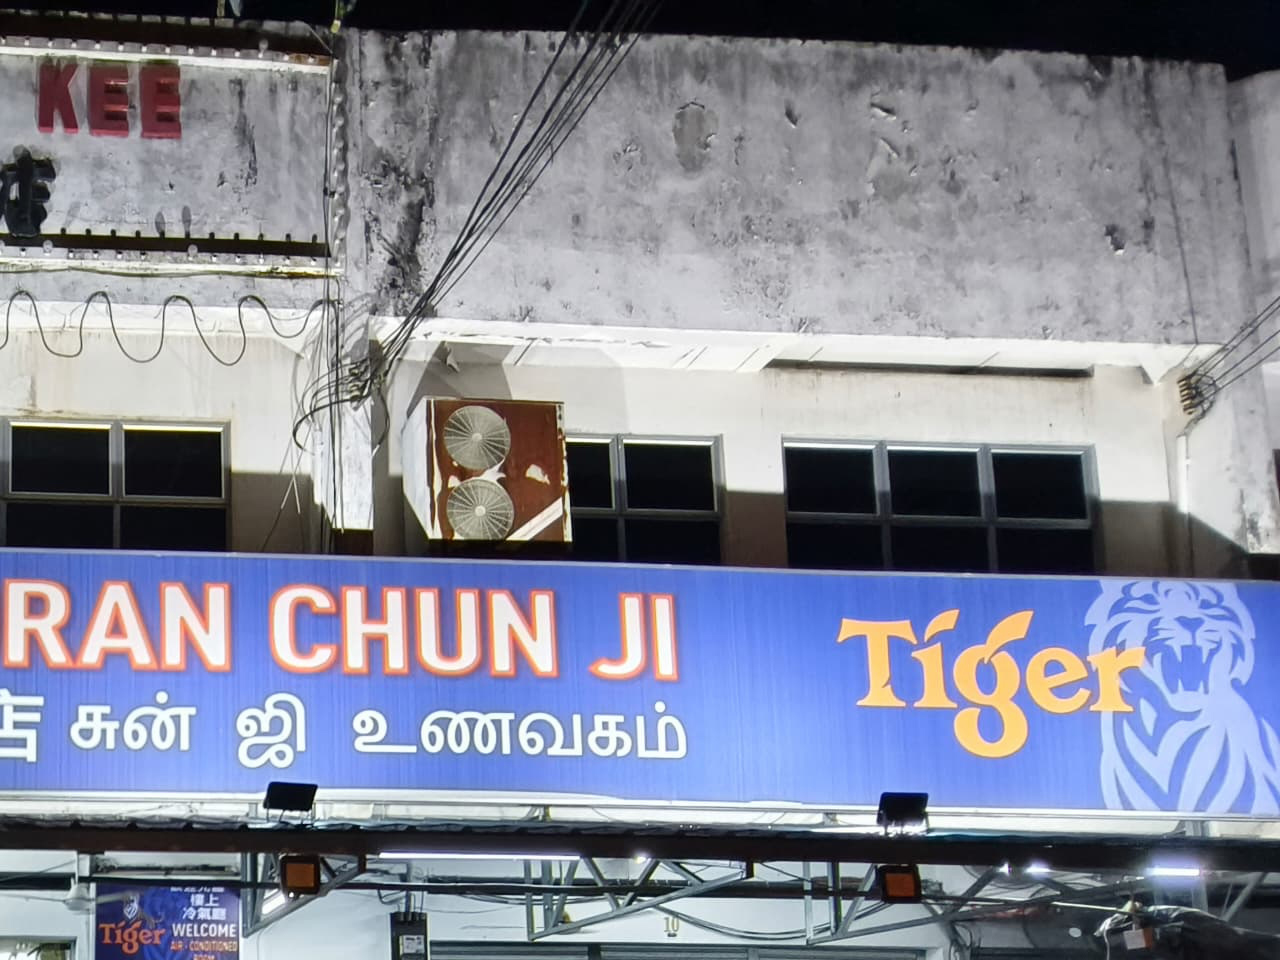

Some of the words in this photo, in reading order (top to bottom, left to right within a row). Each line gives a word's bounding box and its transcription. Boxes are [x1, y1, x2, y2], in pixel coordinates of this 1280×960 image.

[36, 59, 183, 140] KEE
[269, 583, 561, 679] CHUN
[588, 591, 681, 683] JI
[836, 608, 1147, 759] Tiger
[98, 919, 167, 956] Tiger
[171, 923, 238, 938] WELCOME
[663, 916, 680, 932] 10
